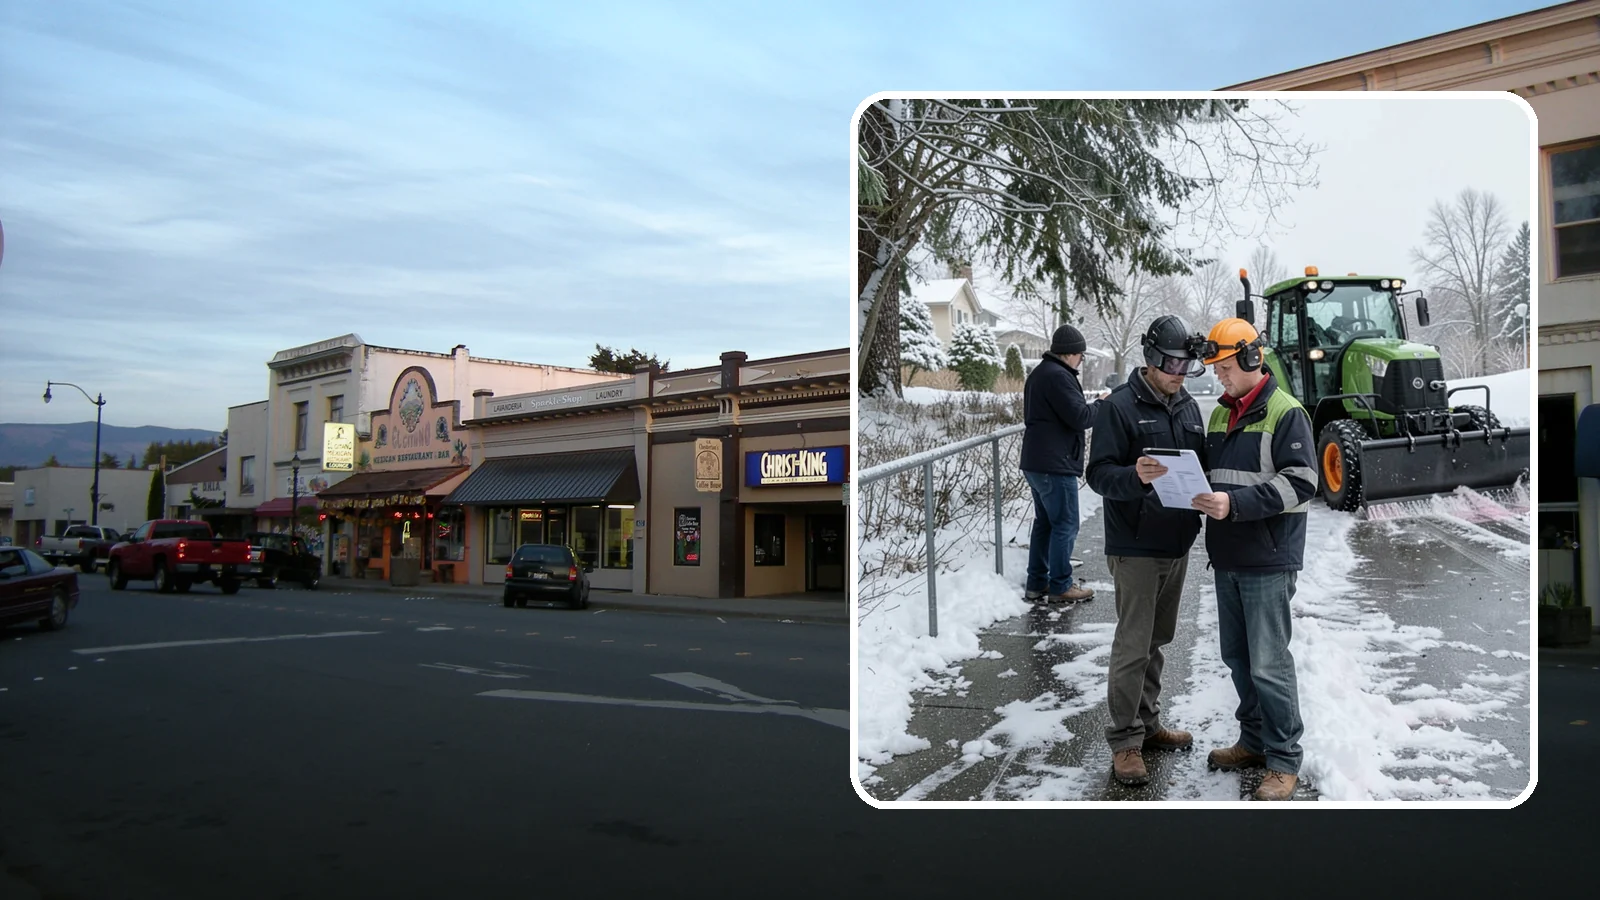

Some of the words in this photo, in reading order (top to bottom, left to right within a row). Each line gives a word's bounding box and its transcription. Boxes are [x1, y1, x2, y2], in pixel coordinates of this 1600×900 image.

[595, 389, 624, 399] LAUNDRY
[493, 402, 522, 412] LAVANDERIA
[530, 398, 560, 409] Sparkle
[562, 394, 583, 405] Shop
[373, 455, 396, 464] MEXICAN
[397, 452, 433, 462] RESTAURANT
[438, 450, 450, 459] BAR
[761, 452, 797, 478] CHRIST
[799, 450, 827, 476] KING
